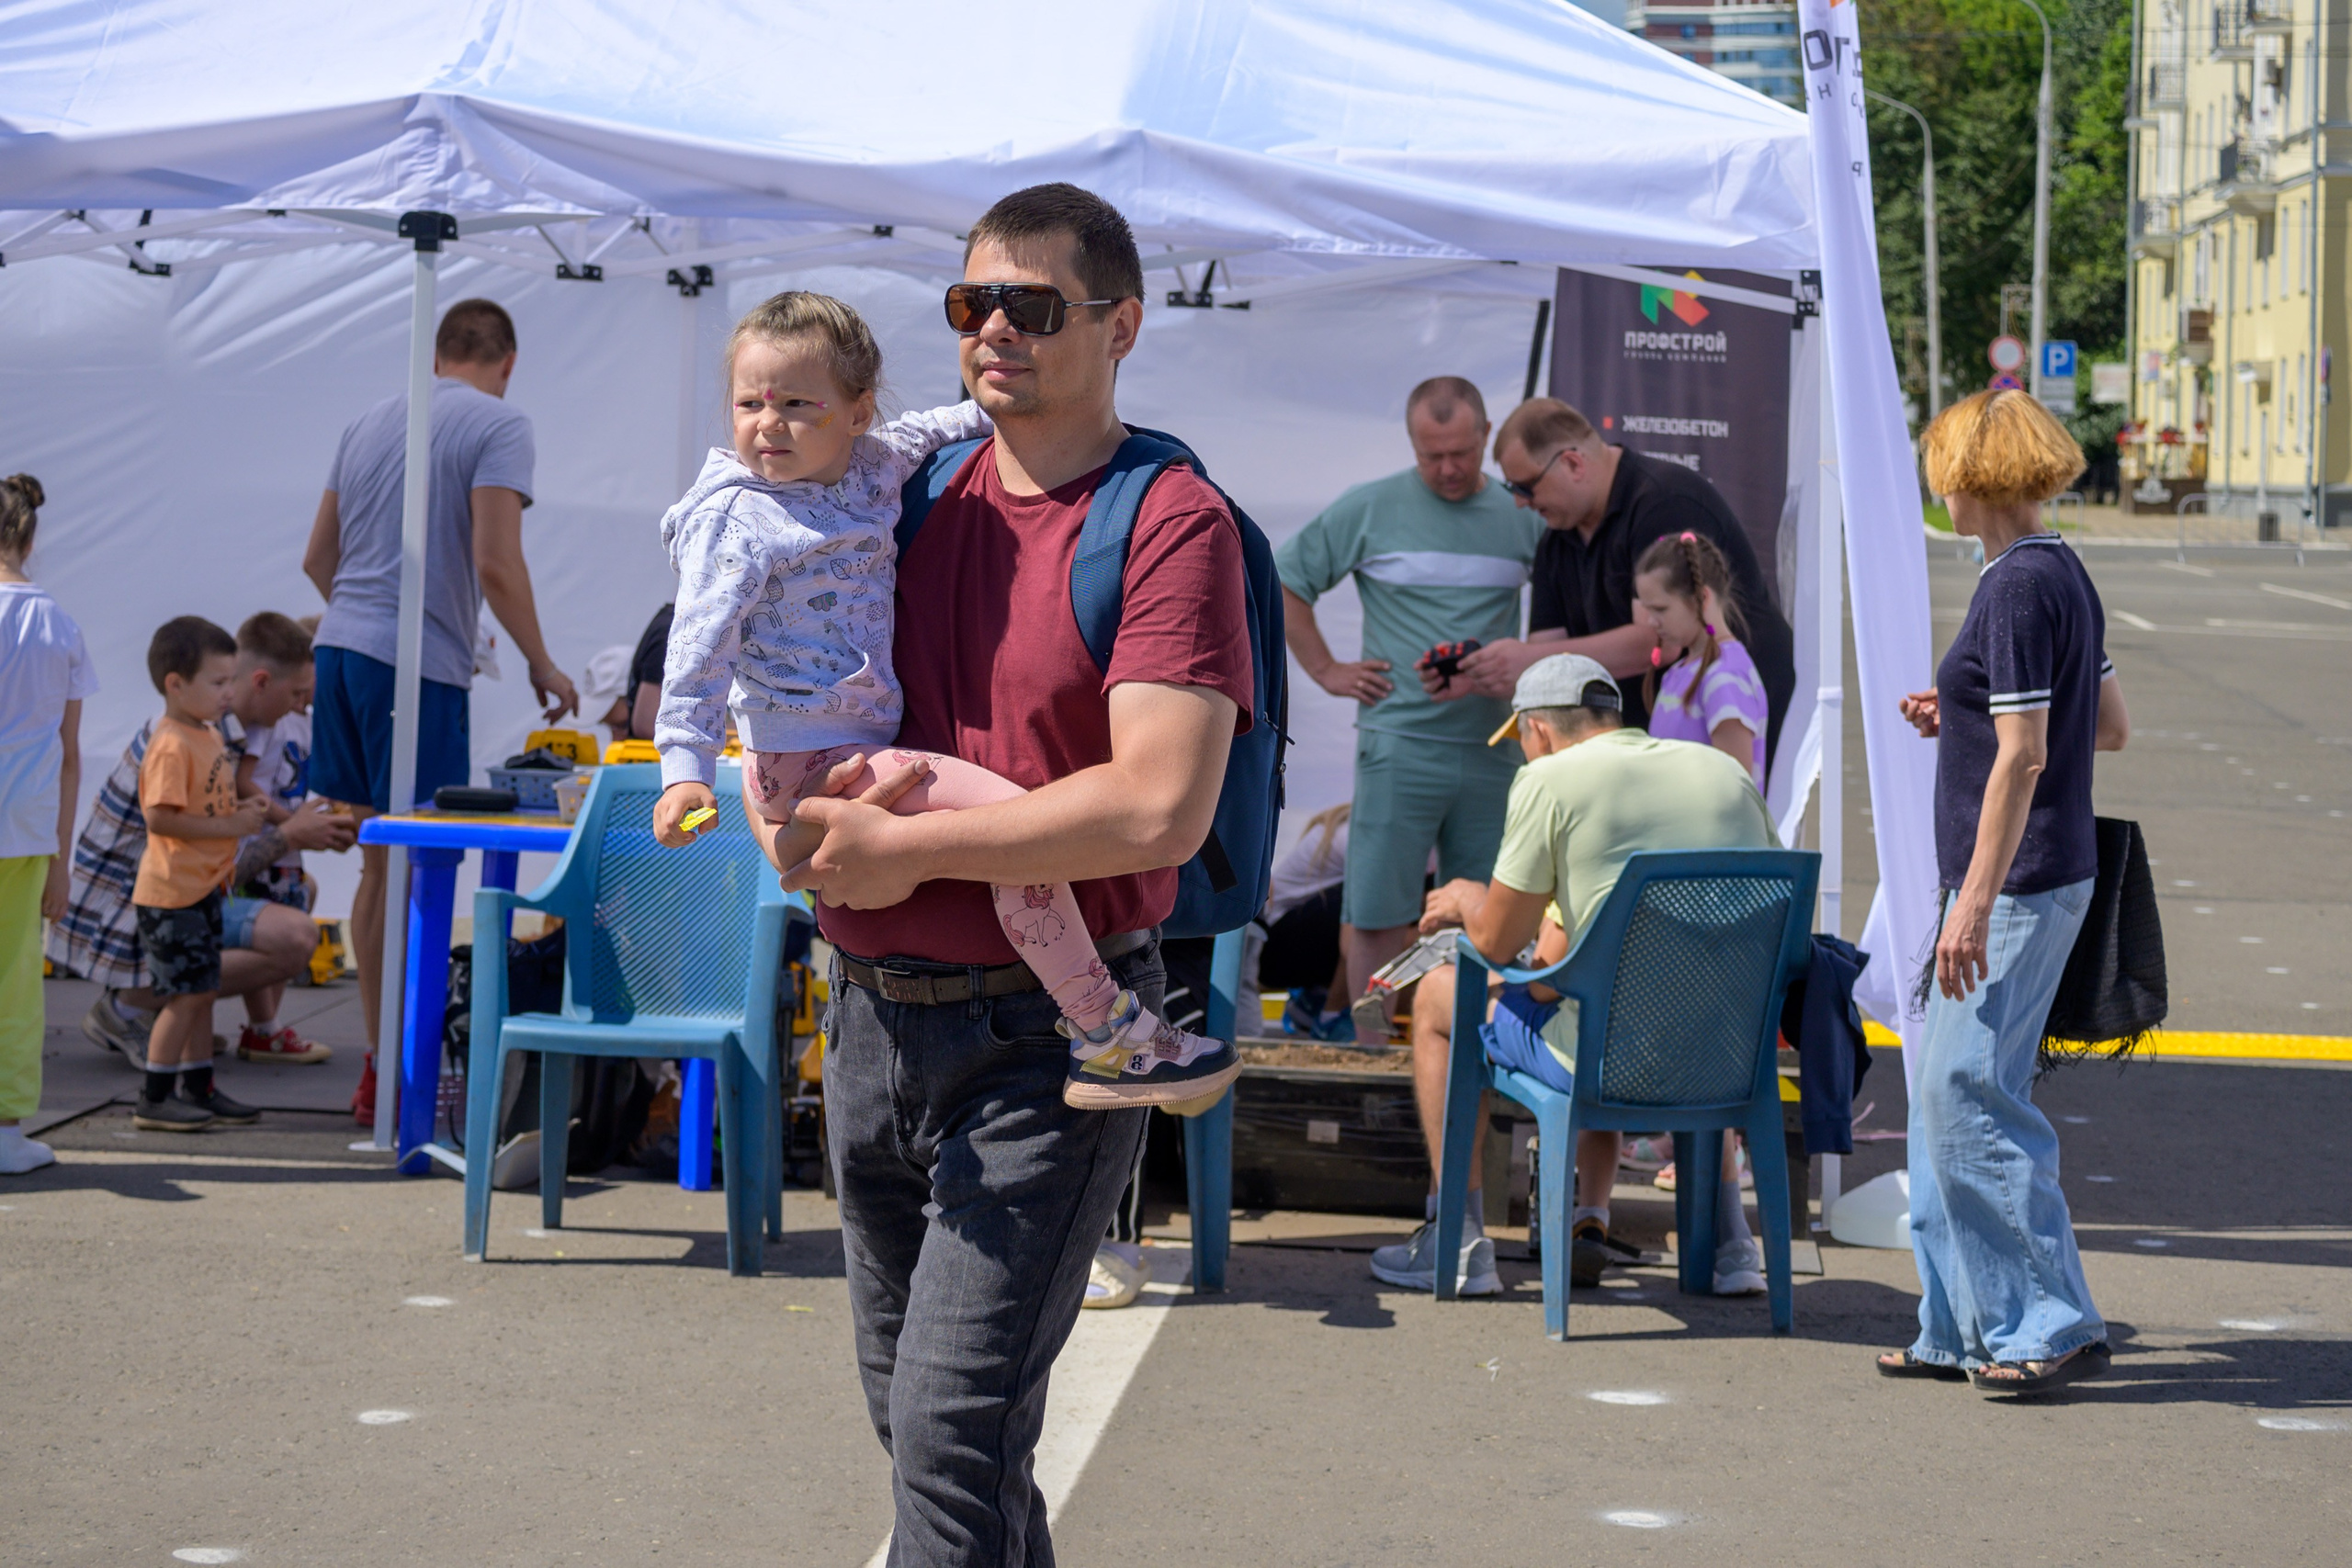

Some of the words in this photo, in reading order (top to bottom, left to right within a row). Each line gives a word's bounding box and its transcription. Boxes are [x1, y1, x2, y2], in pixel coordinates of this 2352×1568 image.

[1624, 332, 1726, 352] ПРОФСТРОЙ
[2048, 344, 2070, 377] P
[1623, 416, 1728, 437] ЖЕЛЕЗОБЕТОН
